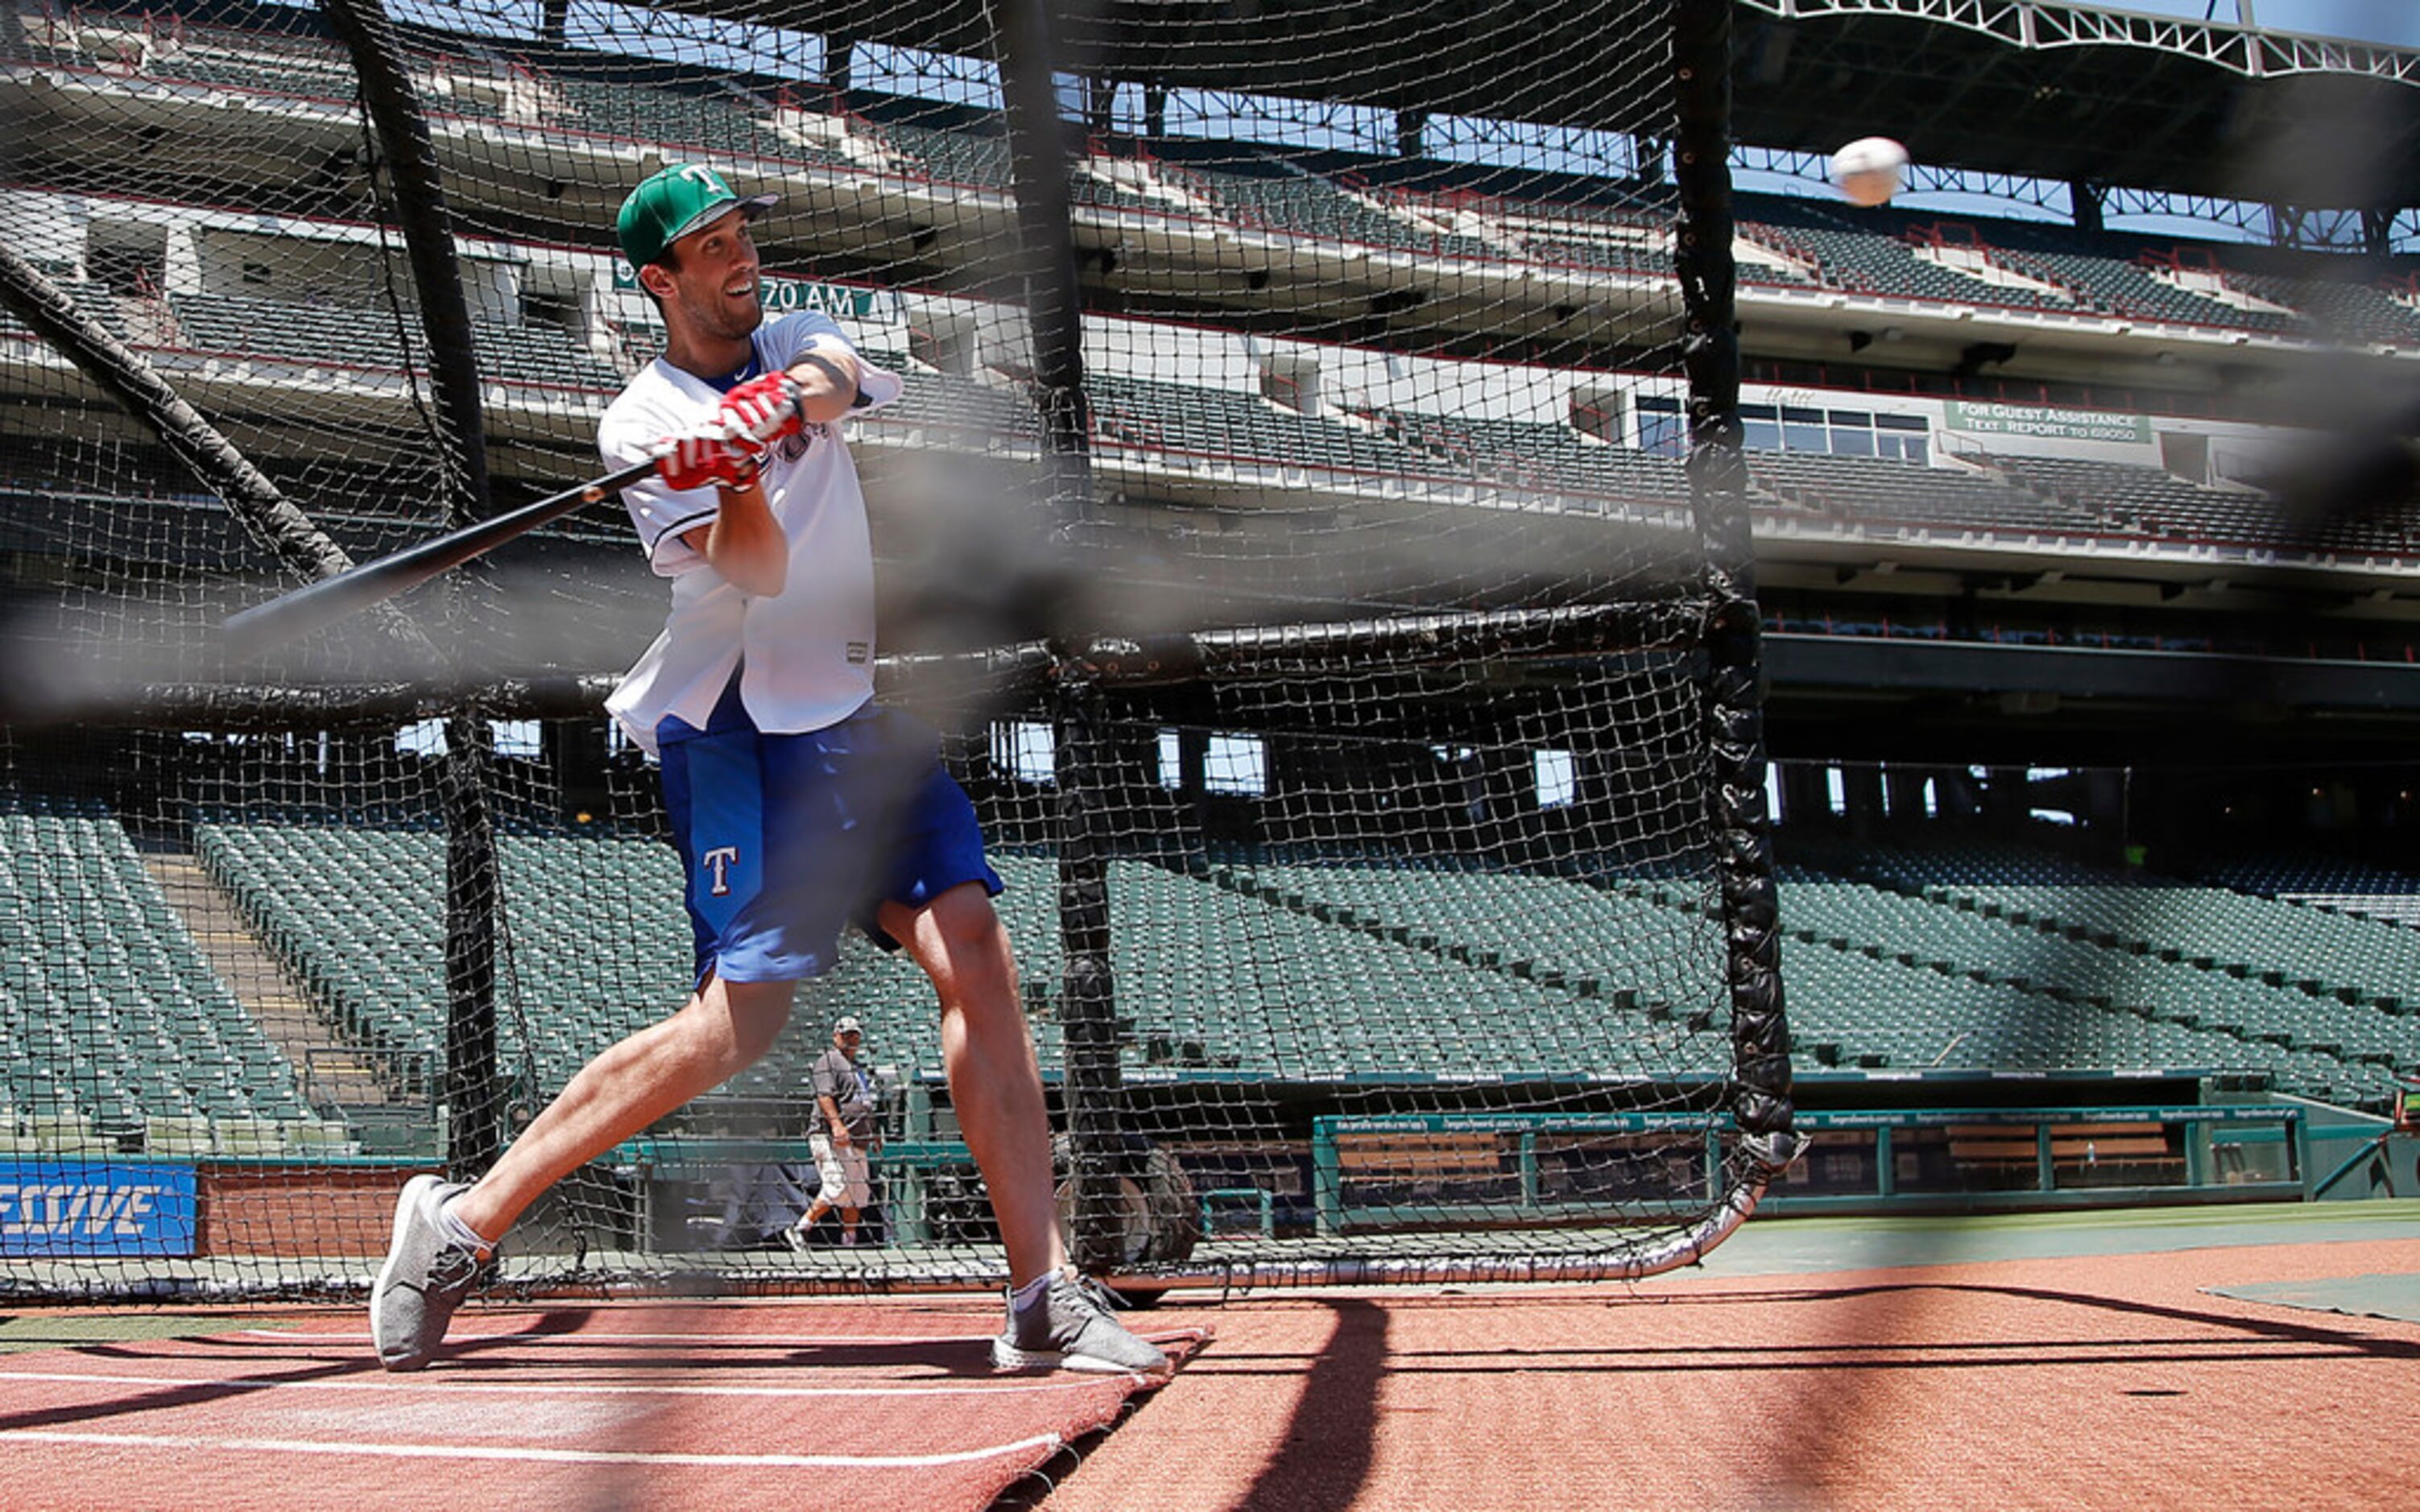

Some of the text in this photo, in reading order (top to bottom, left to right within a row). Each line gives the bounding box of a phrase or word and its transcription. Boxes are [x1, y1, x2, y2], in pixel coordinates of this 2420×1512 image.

[679, 164, 722, 194] T
[806, 284, 855, 316] AM
[1958, 402, 2137, 427] FOR GUEST ASSISTANCE
[2007, 420, 2066, 436] REPORT
[703, 846, 739, 897] T
